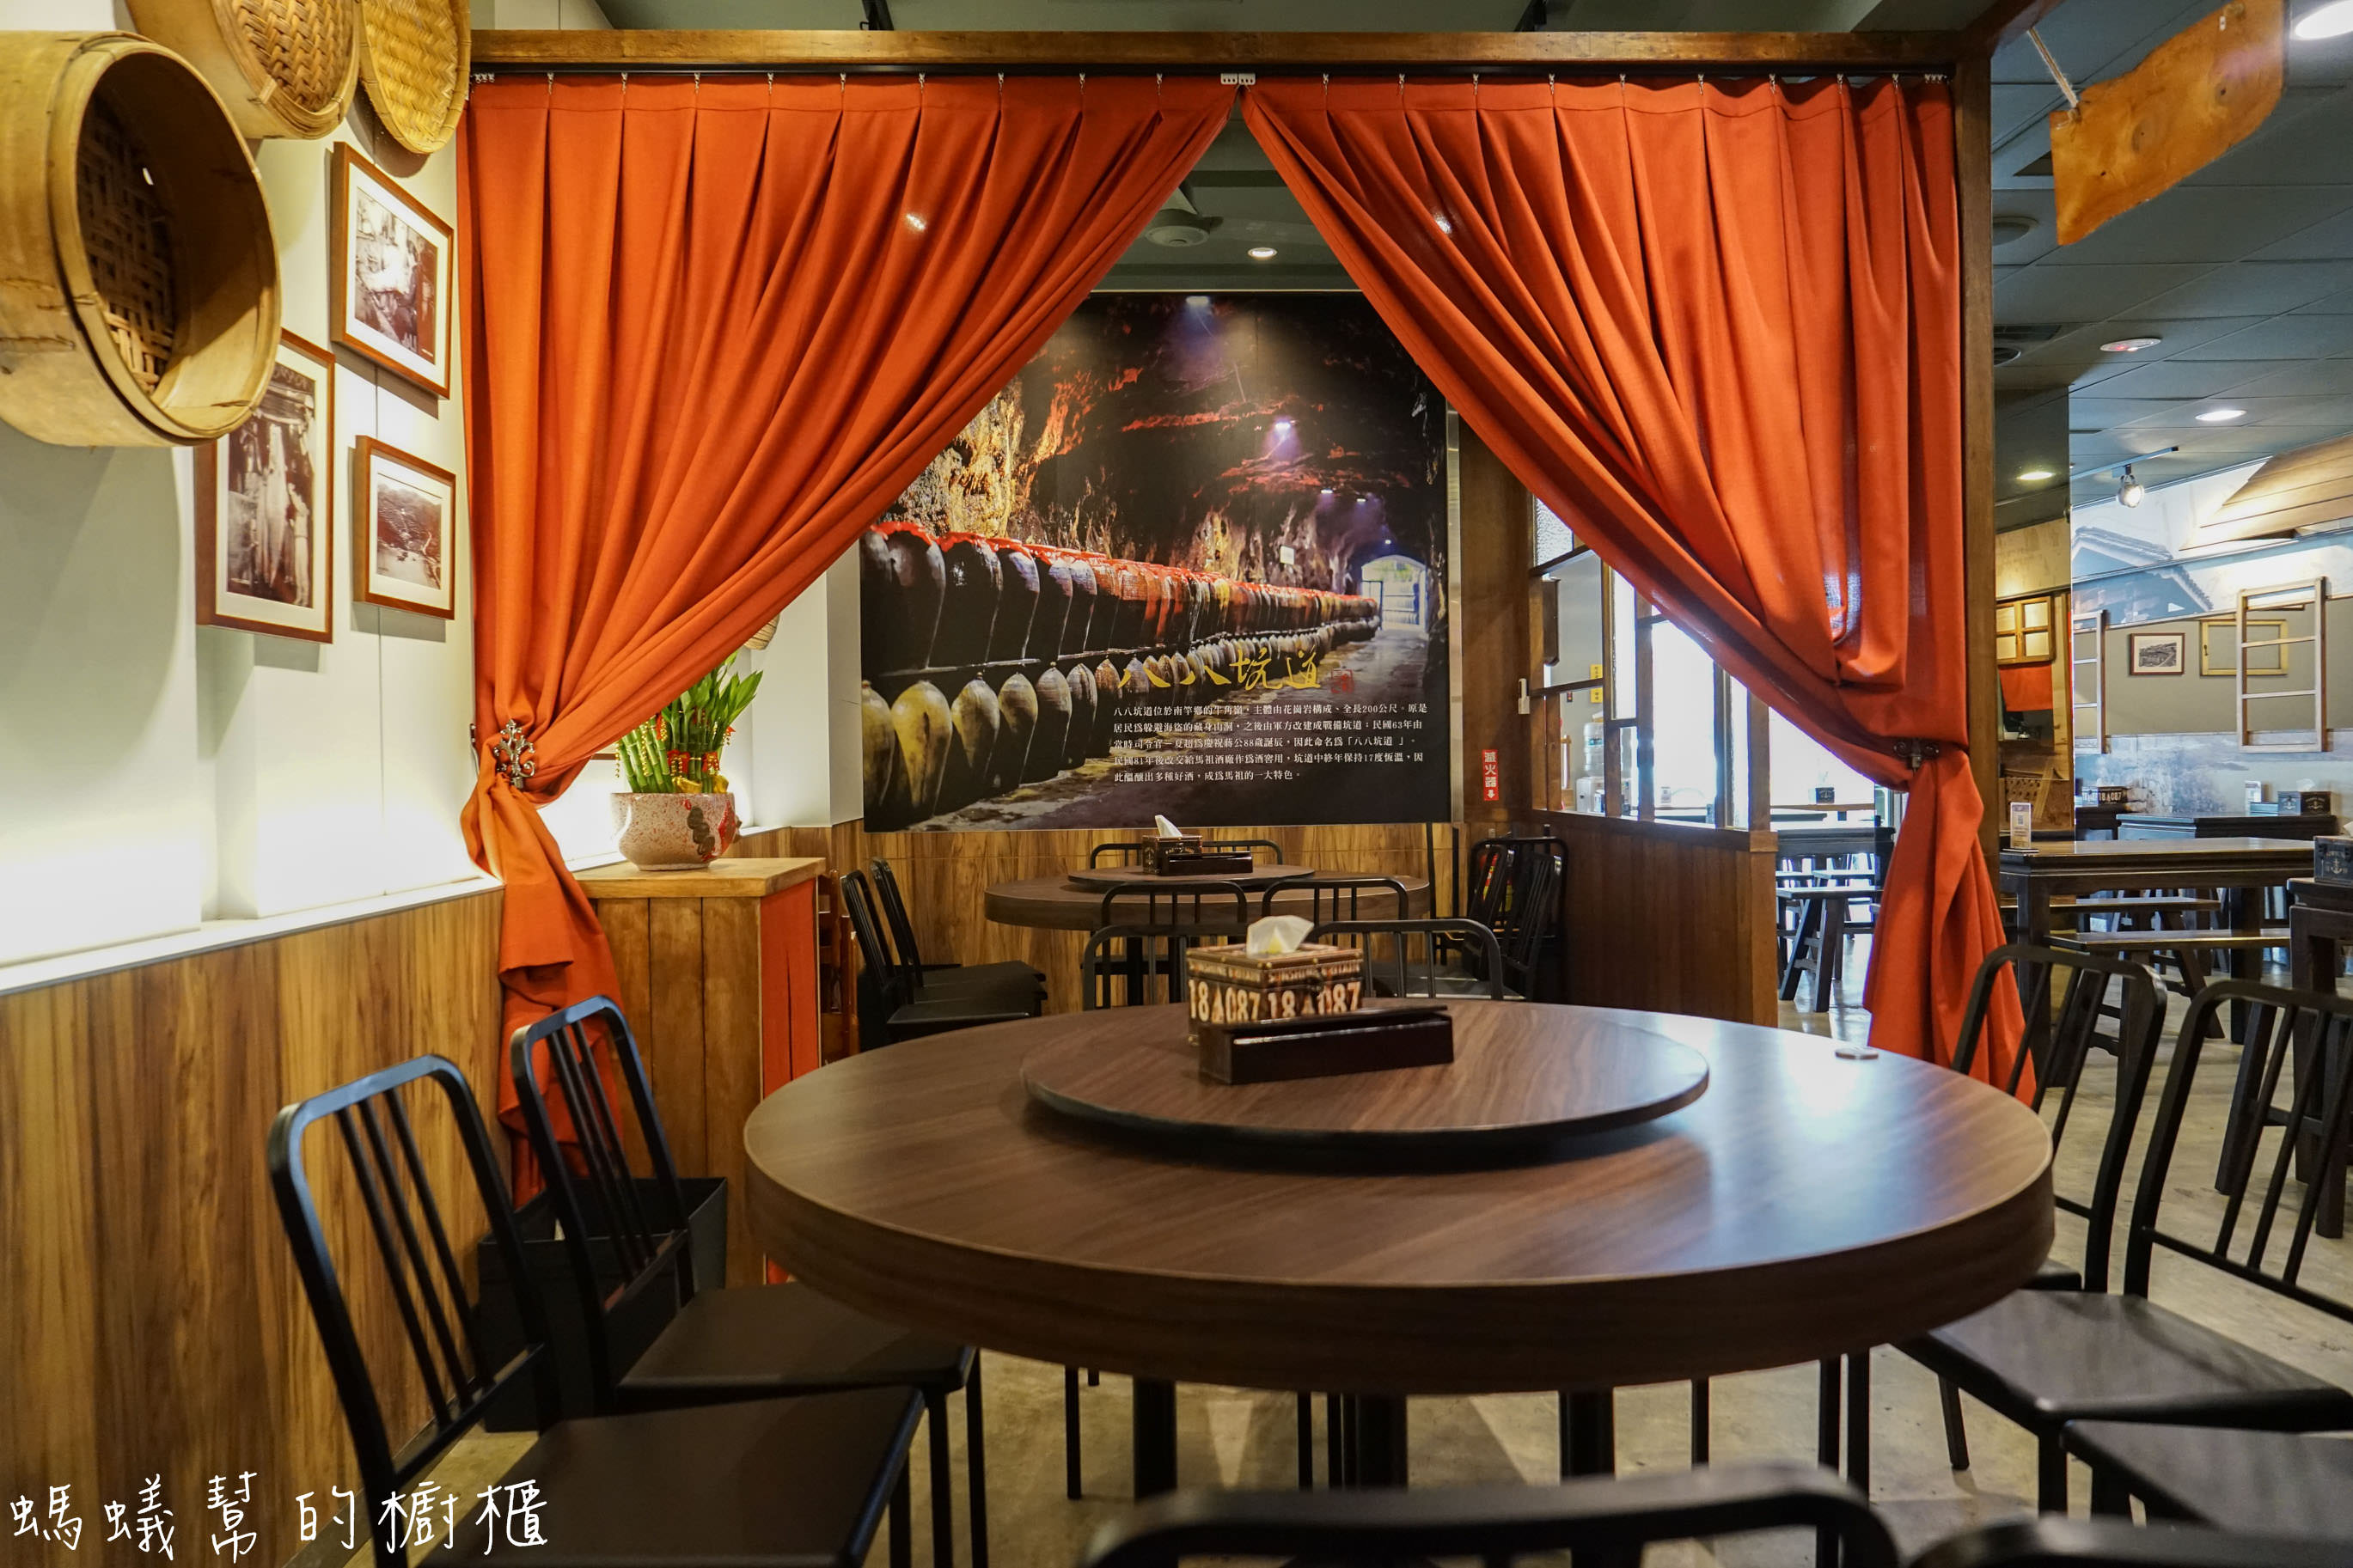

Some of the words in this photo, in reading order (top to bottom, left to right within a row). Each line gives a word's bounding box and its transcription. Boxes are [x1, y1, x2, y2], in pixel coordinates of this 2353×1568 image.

[1118, 644, 1321, 691] 八八坑道
[1484, 752, 1497, 788] 滅火器
